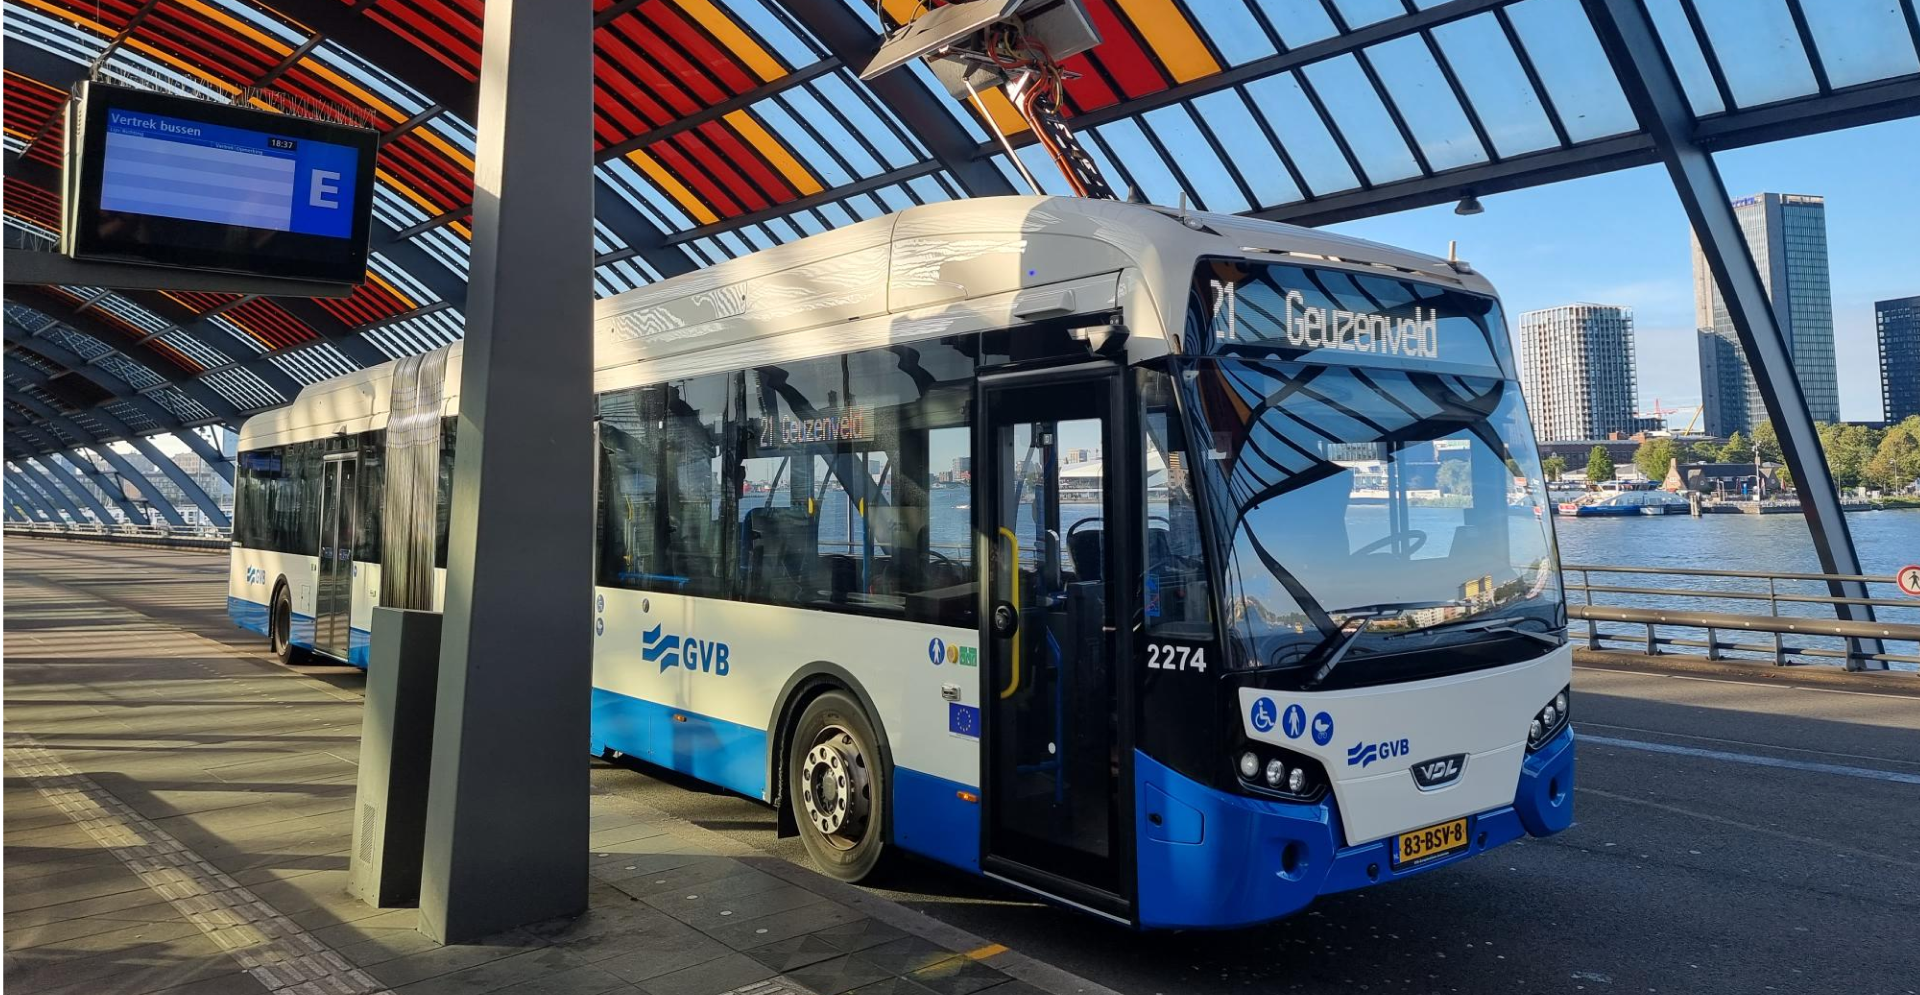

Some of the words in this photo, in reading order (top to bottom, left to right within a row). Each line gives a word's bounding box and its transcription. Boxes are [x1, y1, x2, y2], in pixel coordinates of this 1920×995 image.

[111, 113, 157, 130] Vertrek
[160, 120, 201, 136] bussen
[271, 139, 293, 149] 18:37
[309, 168, 341, 210] E
[1210, 279, 1236, 340] 21
[1285, 290, 1438, 358] Geuzenveld
[760, 415, 773, 447] 21
[782, 406, 864, 443] Geuzenveld
[683, 637, 730, 677] GVB
[1147, 643, 1207, 673] 2274
[1379, 738, 1410, 760] GVB
[1420, 760, 1458, 781] VDL
[1404, 822, 1463, 857] 83-BSV-8
